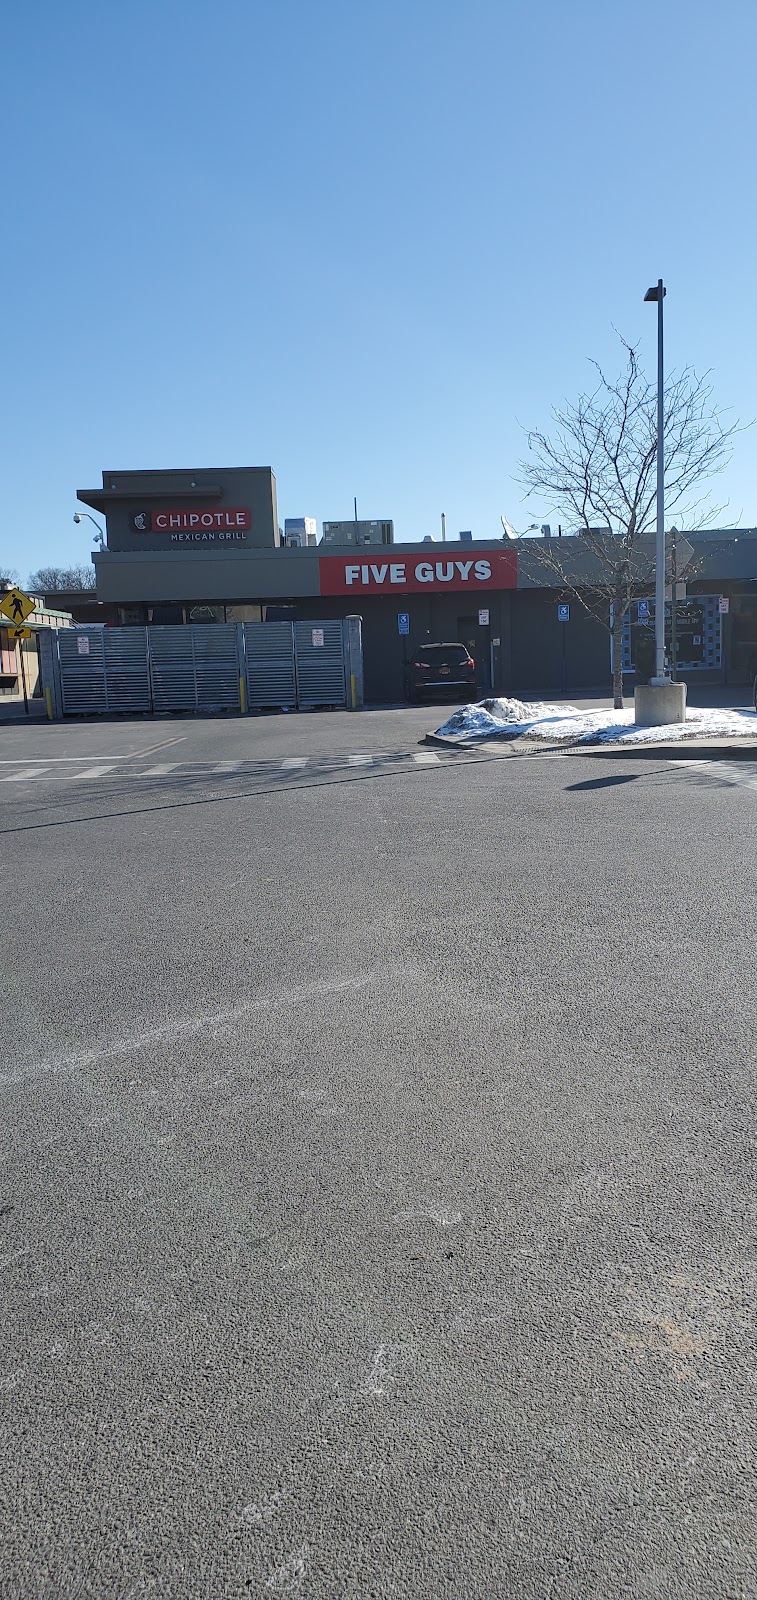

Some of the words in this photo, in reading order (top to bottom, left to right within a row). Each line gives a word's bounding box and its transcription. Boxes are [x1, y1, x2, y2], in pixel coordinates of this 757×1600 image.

[156, 512, 246, 528] CHIPOTLE
[171, 533, 215, 541] MEXICAN
[218, 532, 247, 540] GRILL
[345, 563, 407, 585] FIVE
[415, 560, 492, 583] GUYS
